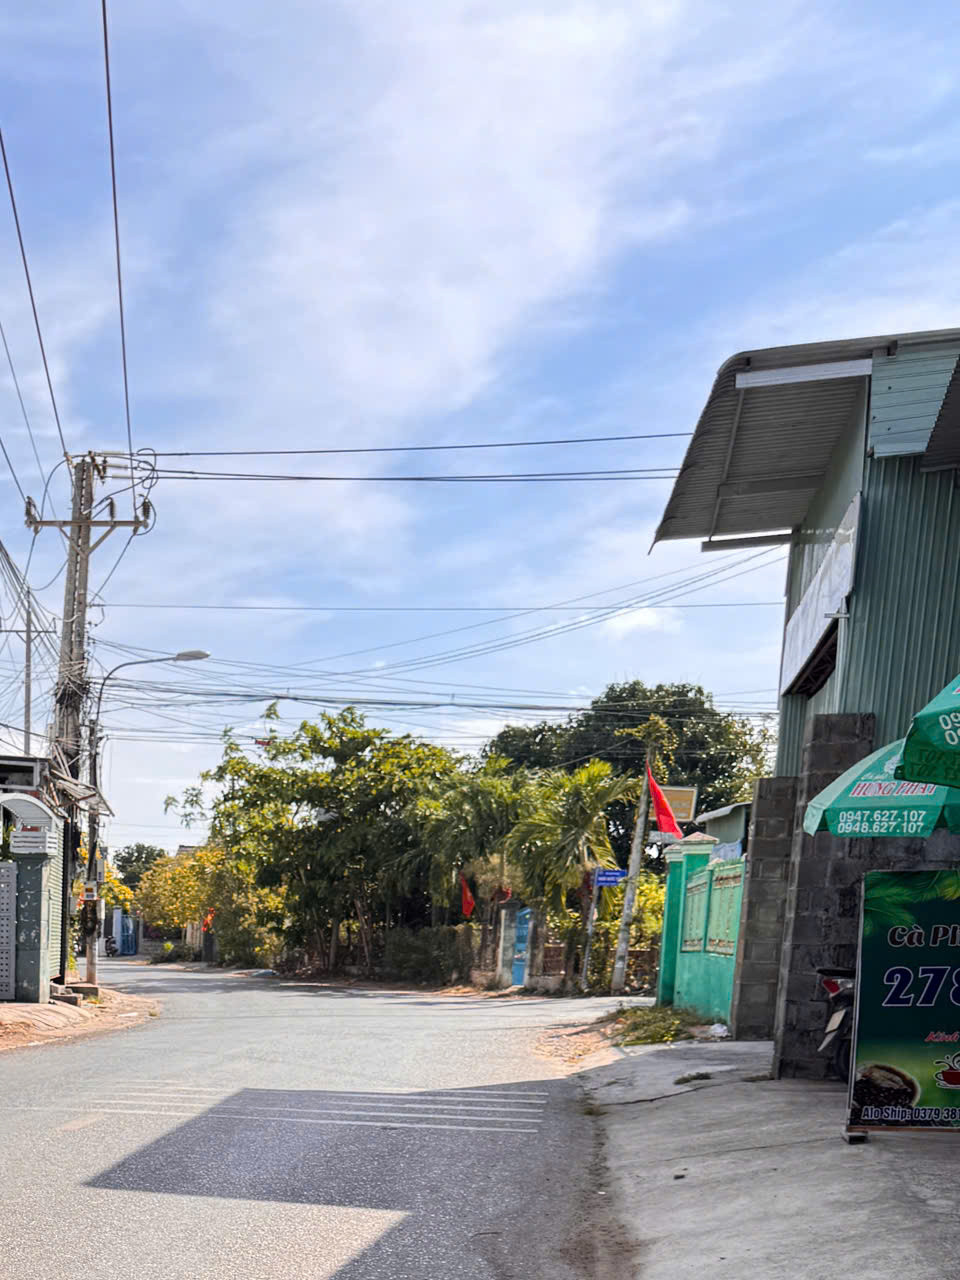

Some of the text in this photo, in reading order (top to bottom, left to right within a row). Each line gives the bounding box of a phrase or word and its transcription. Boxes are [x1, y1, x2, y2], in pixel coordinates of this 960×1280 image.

[839, 810, 926, 822] 0947.627.107
[837, 822, 924, 833] 0948.627.107
[887, 924, 926, 948] Cà
[861, 1105, 881, 1120] Alo
[882, 1105, 912, 1122] Ship:
[912, 1106, 941, 1121] 0379
